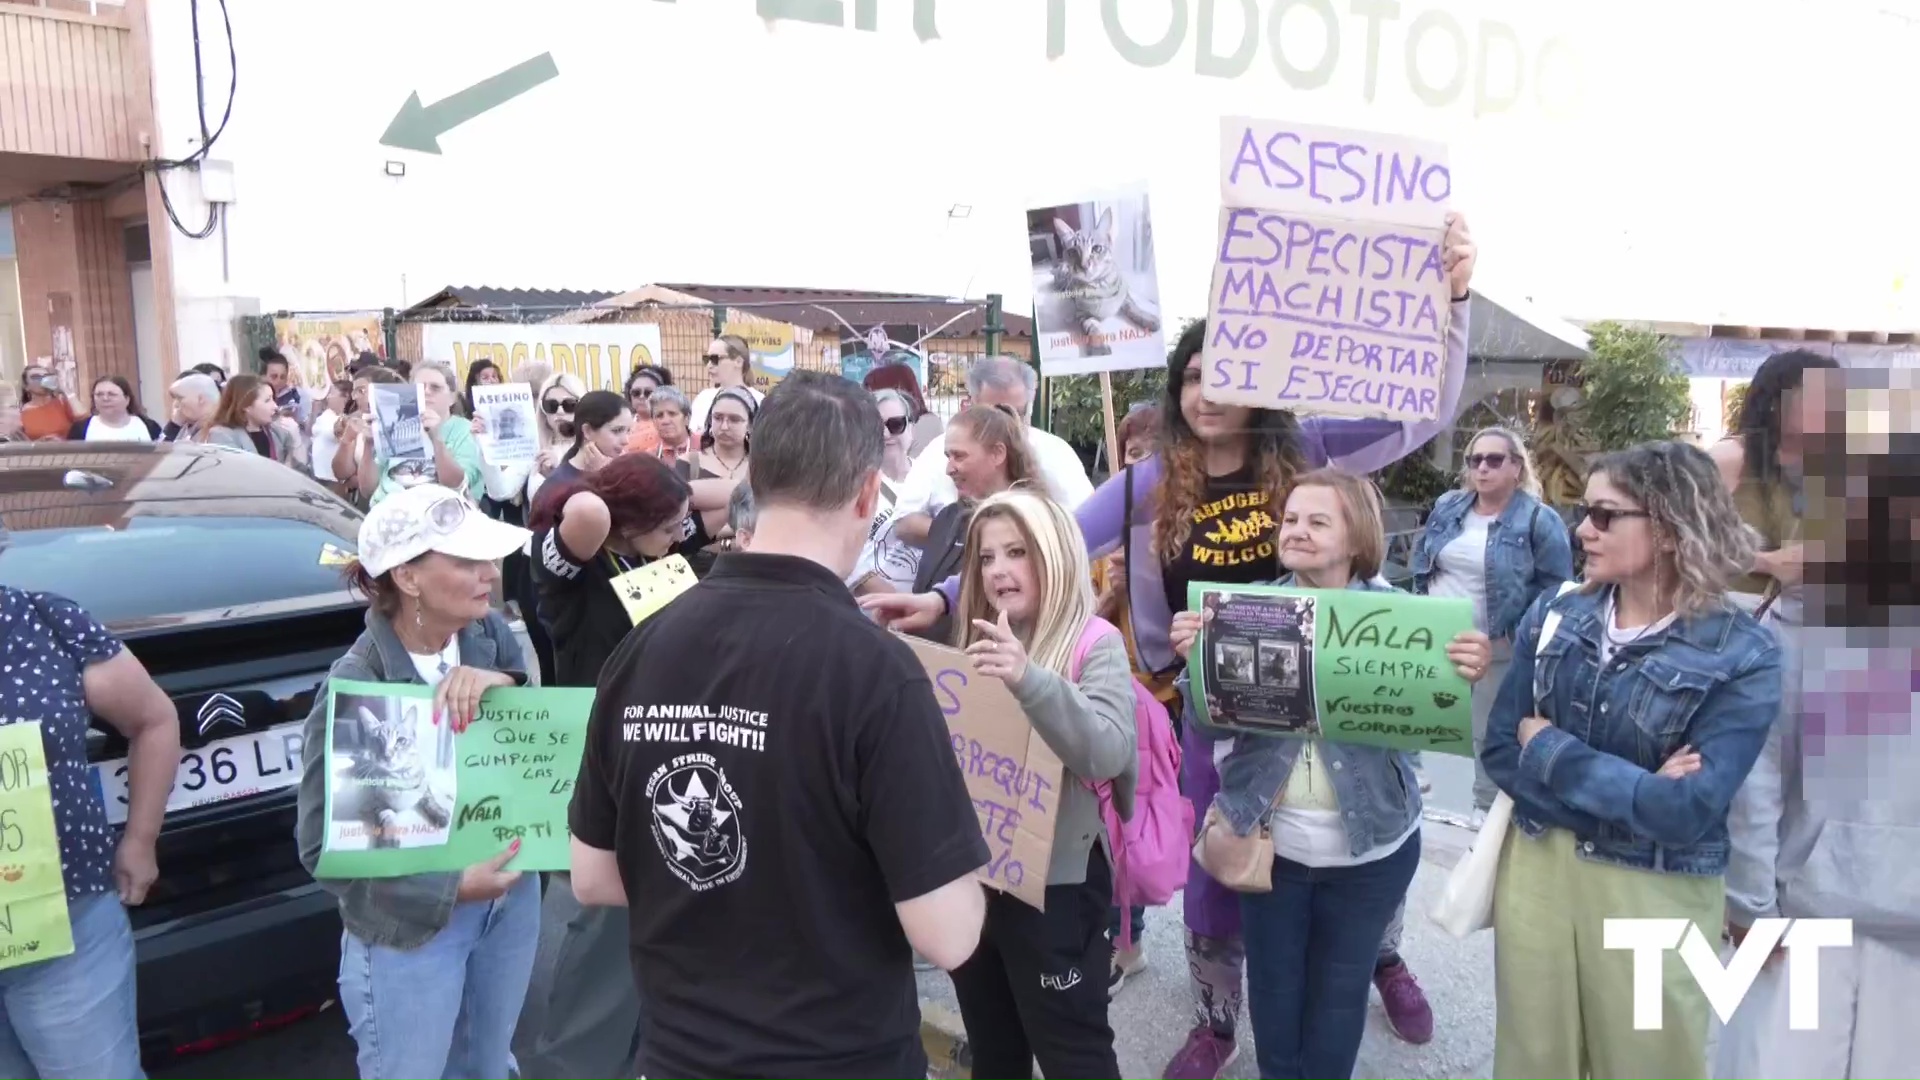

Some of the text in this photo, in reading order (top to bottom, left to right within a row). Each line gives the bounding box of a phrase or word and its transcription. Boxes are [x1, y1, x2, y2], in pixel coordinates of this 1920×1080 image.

[1229, 127, 1451, 206] ASESINO
[1219, 207, 1444, 282] ESPECISTA
[1218, 267, 1438, 332] MACHISTA
[1211, 320, 1439, 378] NO DEPORTAR
[1210, 358, 1438, 414] SI EJECUTAR
[478, 393, 530, 405] ASESINO
[1323, 606, 1433, 650] NALA
[1333, 657, 1439, 679] SIEMPRE
[1373, 685, 1404, 697] EN
[624, 705, 769, 727] FOR ANIMAL JUSTICE
[493, 727, 570, 745] QUE SE
[623, 721, 766, 752] WE WILL FIGHT!!
[464, 754, 556, 768] CUMPLAN
[672, 753, 717, 768] STRIKE
[114, 746, 238, 805] 336
[522, 769, 553, 779] LAS
[550, 779, 577, 794] LE
[457, 795, 502, 830] NALA
[493, 822, 527, 843] POR
